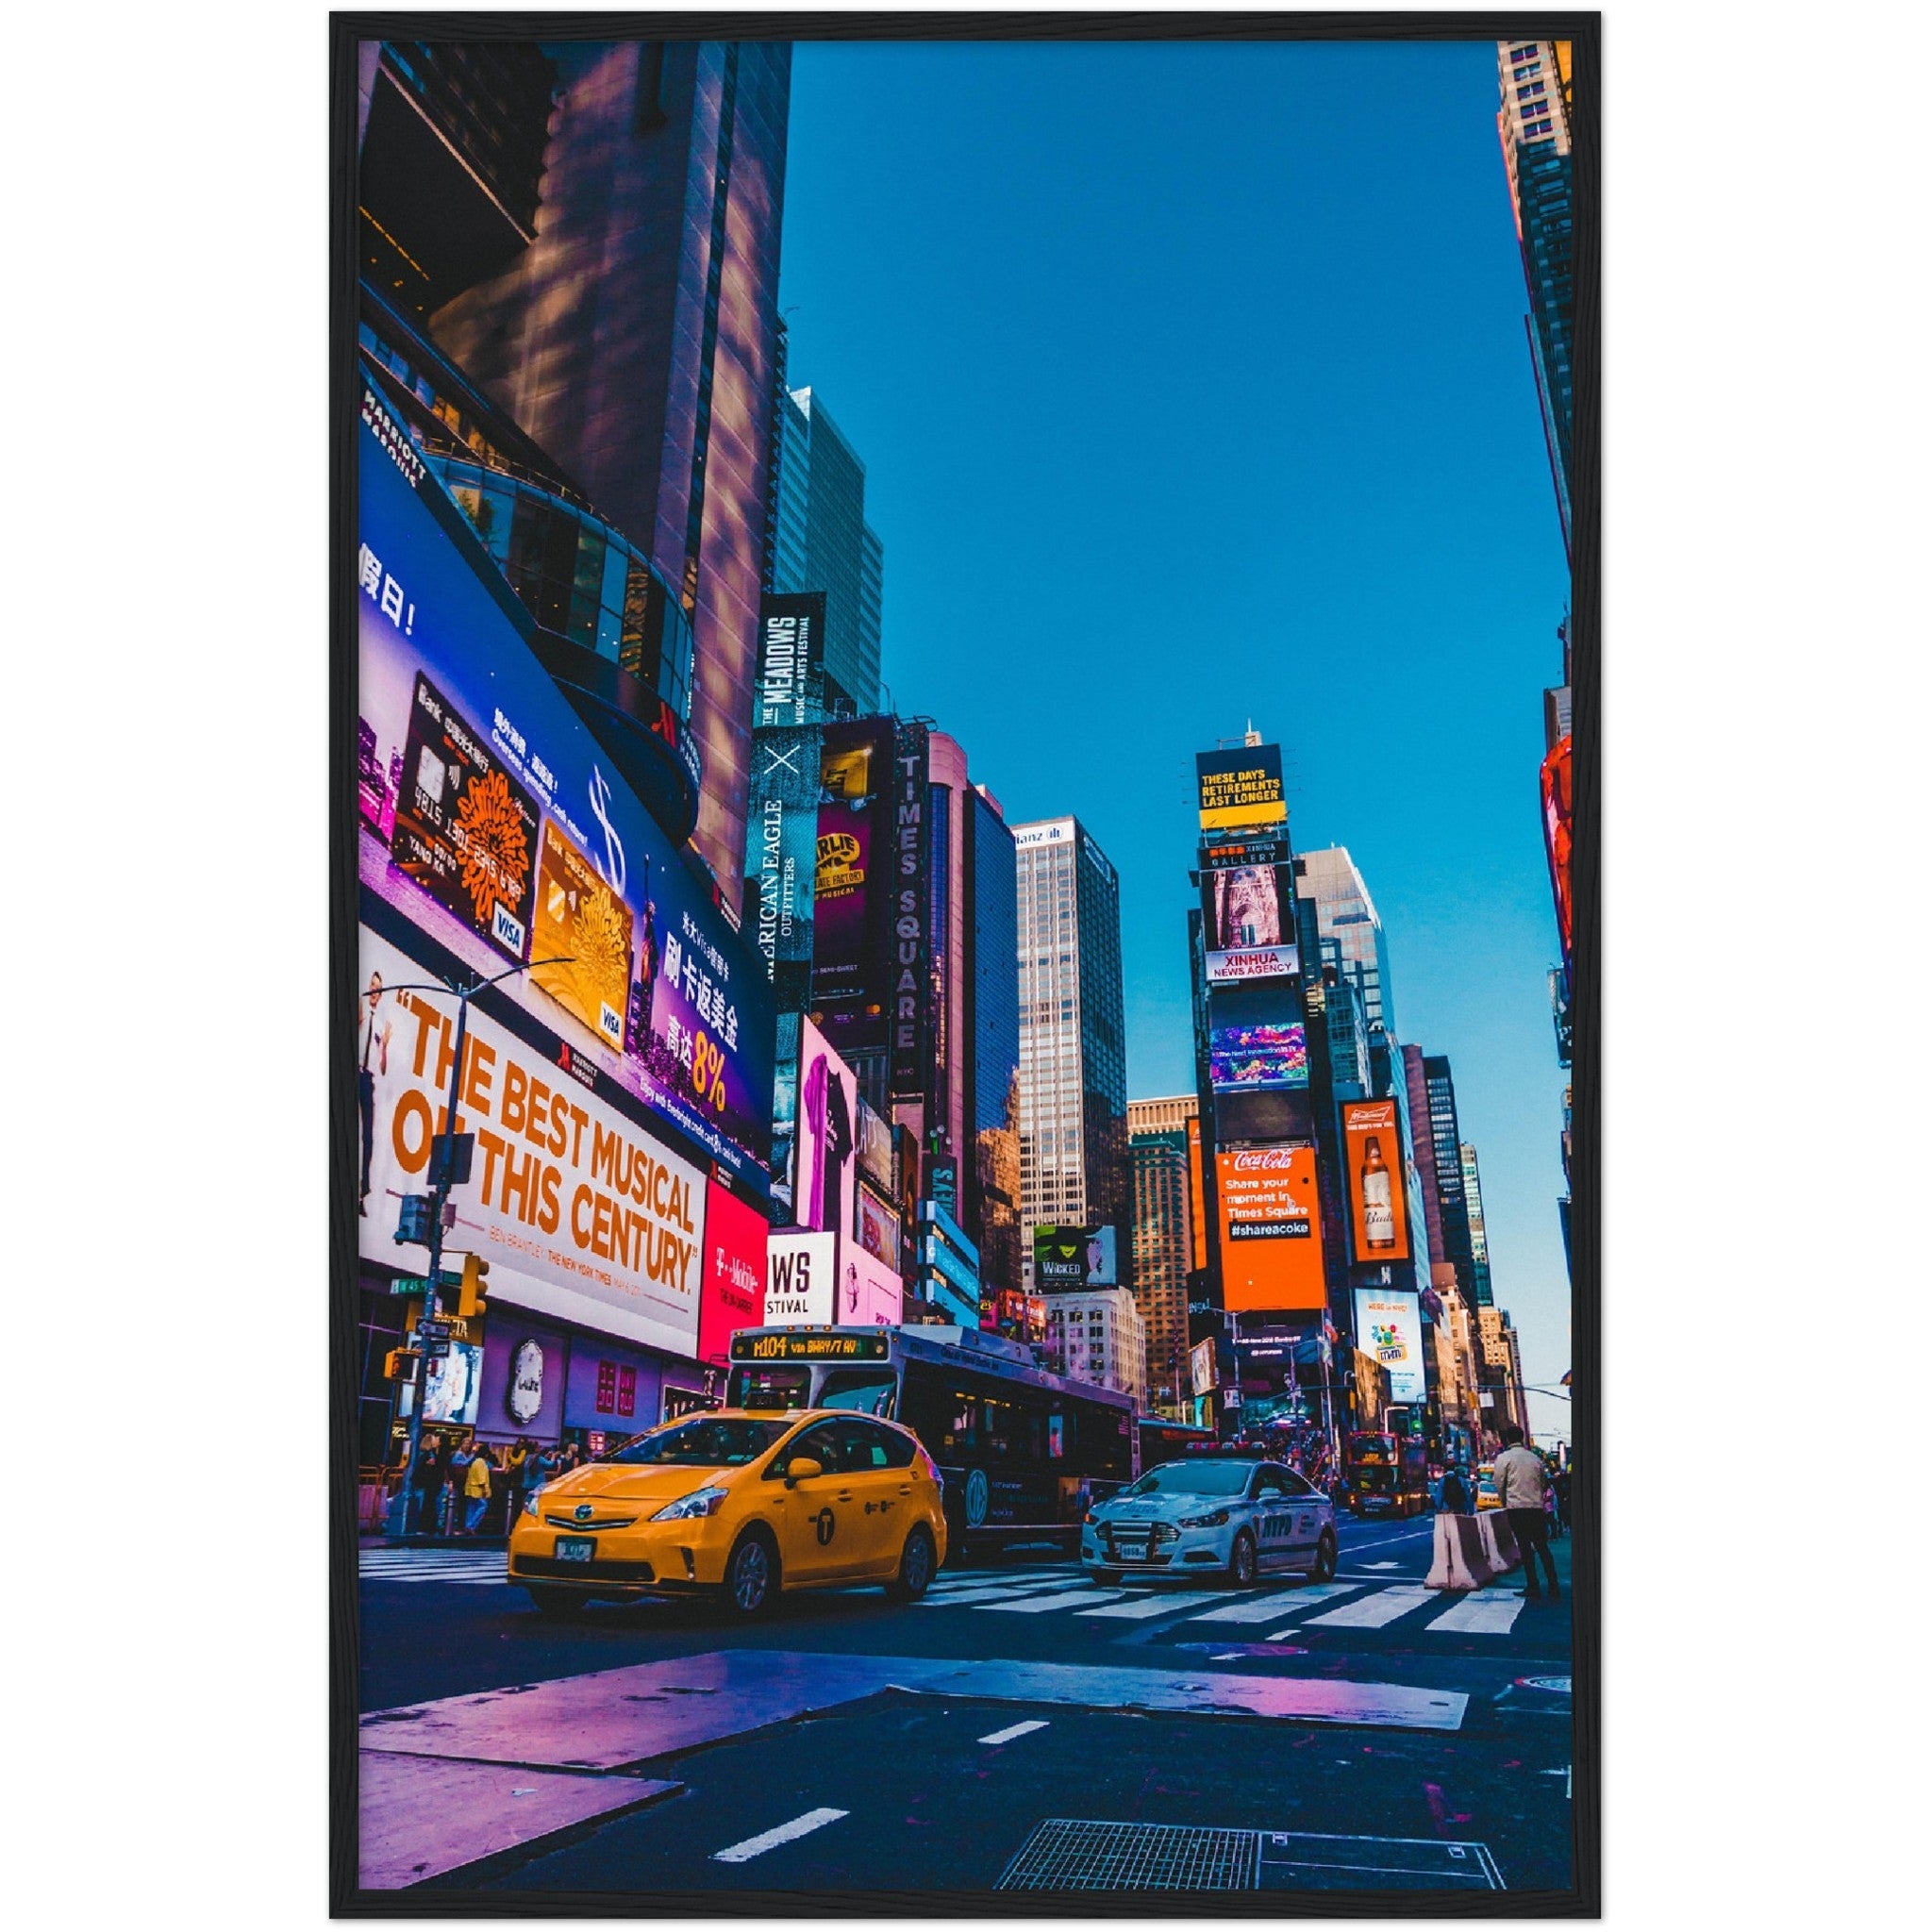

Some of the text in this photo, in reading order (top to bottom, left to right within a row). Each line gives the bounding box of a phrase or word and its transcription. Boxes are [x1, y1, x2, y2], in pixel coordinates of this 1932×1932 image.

[364, 389, 426, 480] MARRIOTT
[797, 616, 810, 656] FESTIVAL
[762, 616, 797, 726] THE MEADOWS
[796, 658, 808, 680] ARTS
[794, 695, 806, 724] MUSIC
[1202, 769, 1266, 786] THESE DAYS
[1202, 778, 1281, 797] RETIREMENTS
[1203, 790, 1279, 808] LAST LONGER
[817, 834, 855, 860] RLIE
[1016, 832, 1043, 844] ianz
[1211, 853, 1276, 867] GALLERY
[832, 871, 861, 885] FACTORY
[758, 799, 782, 984] ERICAN EAGLE
[781, 857, 795, 937] OUTFITTERS
[822, 887, 855, 899] MUSICAL
[896, 756, 921, 1048] TIMES SQUARE
[497, 911, 521, 949] VISA
[1214, 962, 1292, 978] NEWS AGENCY
[1224, 952, 1279, 967] XINHUA
[663, 931, 739, 1053] 刷卡返美金
[602, 1007, 621, 1038] VISA
[500, 1059, 589, 1169] BEST
[591, 1120, 695, 1236] MUSICAL
[1234, 1148, 1294, 1172] Coca-Cola
[477, 1127, 563, 1236] THIS
[1225, 1178, 1290, 1190] Share your
[1226, 1191, 1291, 1205] moment in
[1227, 1207, 1308, 1219] Times Square
[1231, 1223, 1308, 1237] #shareacoke
[489, 1225, 507, 1243] BEN
[548, 1248, 561, 1266] THE
[561, 1255, 576, 1271] NEW
[577, 1260, 594, 1277] YORK
[595, 1269, 612, 1287] TIMES
[1042, 1261, 1081, 1274] WICKED
[771, 1251, 811, 1294] WS
[766, 1299, 809, 1314] STIVAL
[753, 1336, 788, 1357] M104
[807, 1340, 842, 1354] BWAY/7
[842, 1340, 858, 1354] AV
[1262, 1513, 1292, 1538] NYPD
